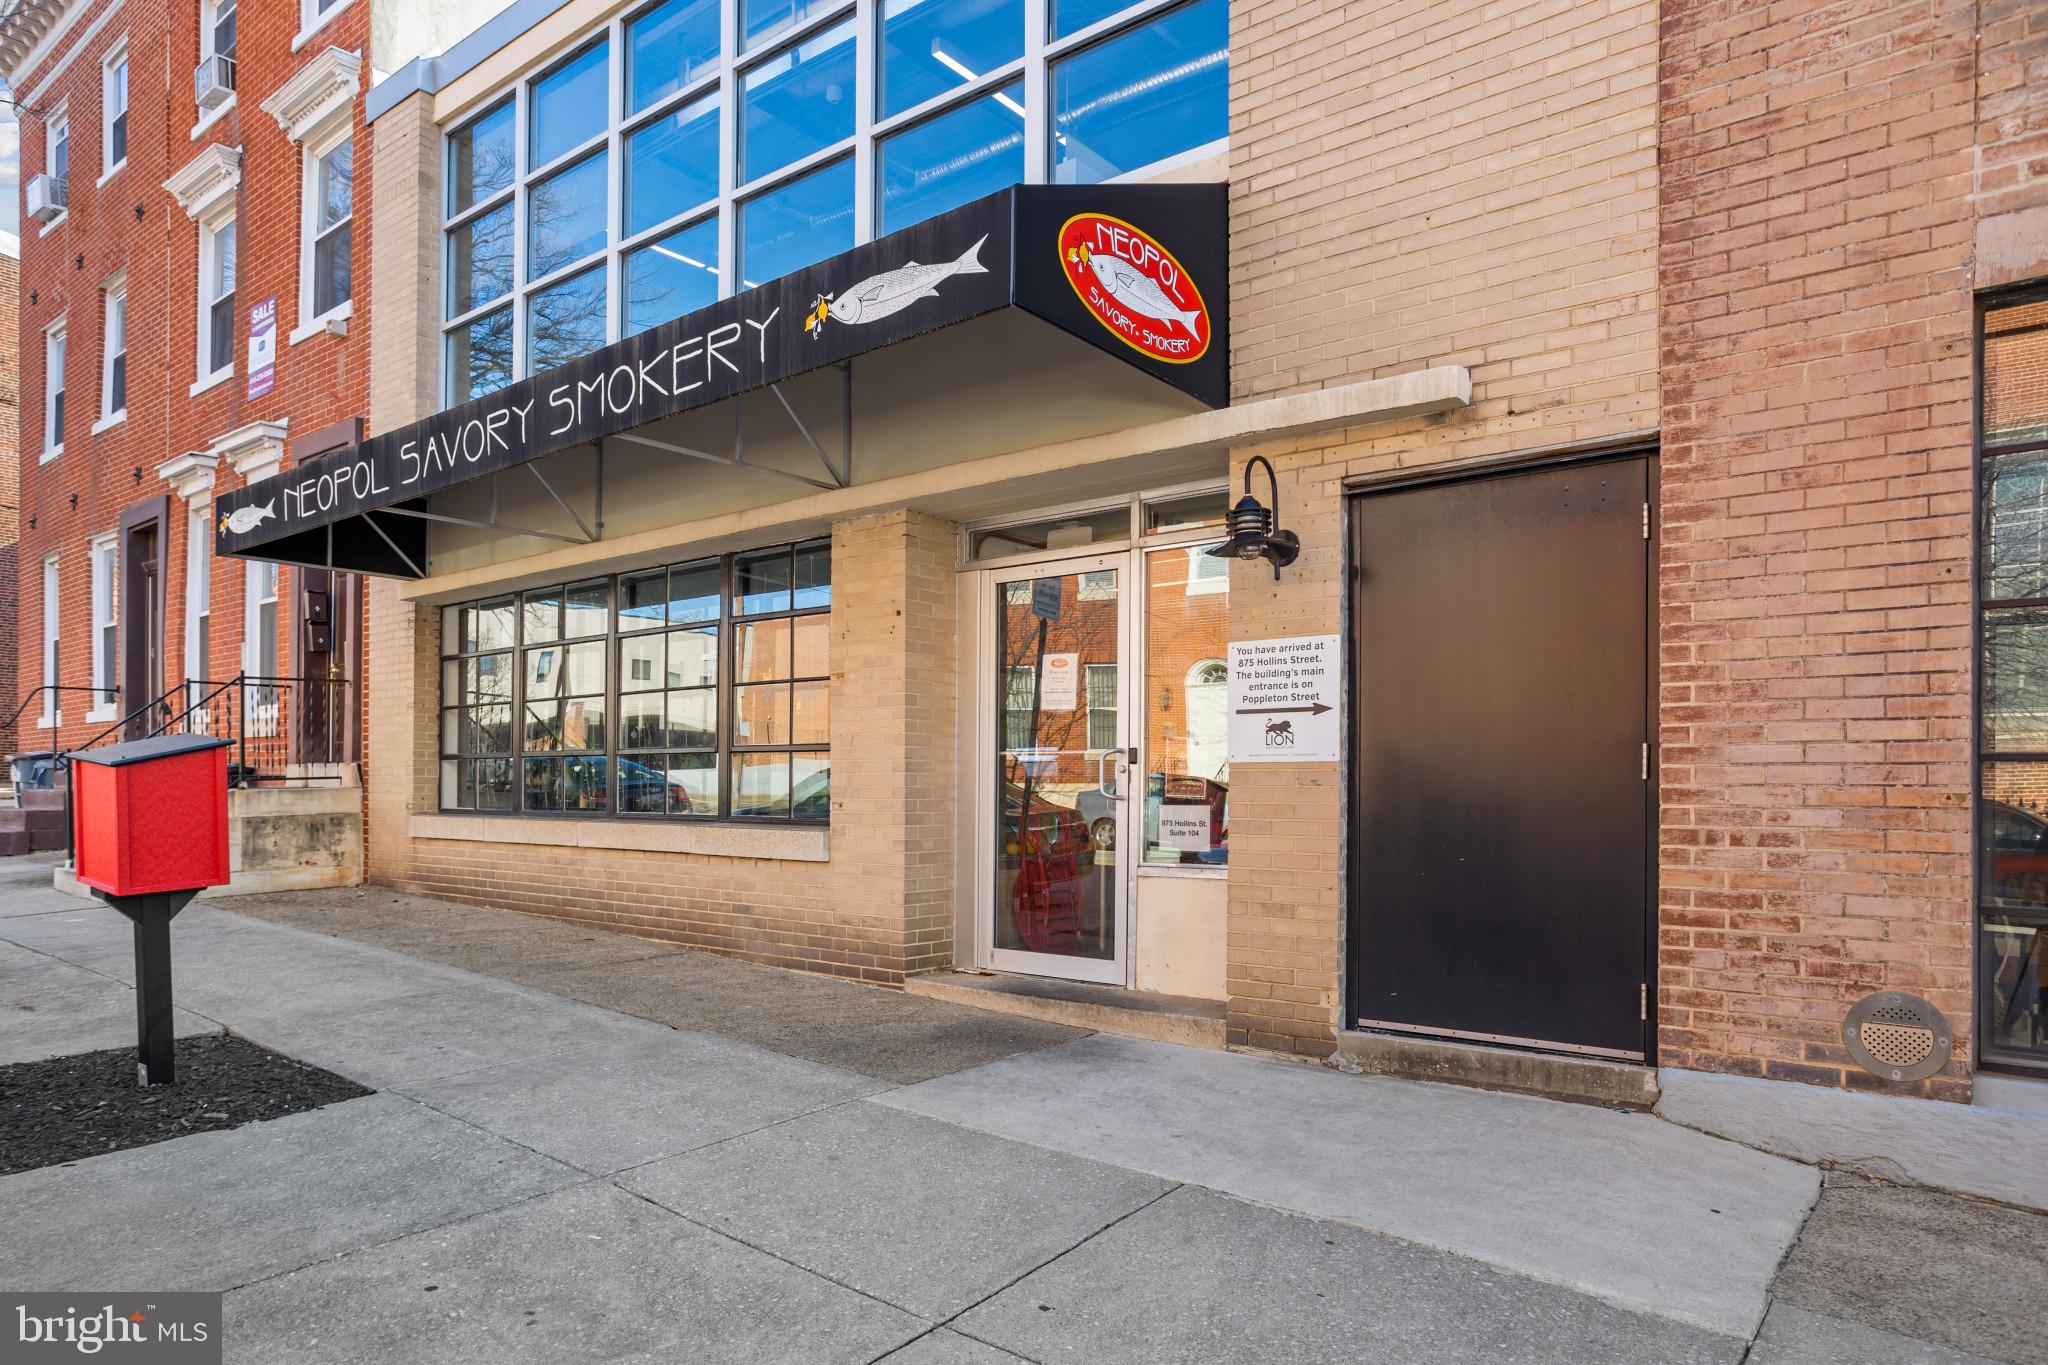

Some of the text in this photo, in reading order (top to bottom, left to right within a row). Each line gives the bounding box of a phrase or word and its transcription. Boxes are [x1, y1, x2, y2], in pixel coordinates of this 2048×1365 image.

[1096, 222, 1184, 303] NEOPOL
[252, 300, 274, 324] SALE
[1143, 330, 1190, 353] SMOKERY
[283, 306, 780, 521] NEOPOL SAVORY SMOKERY
[1236, 641, 1324, 656] You have arrived at
[1238, 655, 1322, 668] 875 Hollins Street.
[1236, 667, 1324, 680] The building's main
[1248, 680, 1313, 691] entrance is on
[1242, 692, 1320, 705] Poppleton Street
[1265, 733, 1294, 746] LION
[1198, 820, 1208, 828] St.
[1169, 829, 1200, 837] Suite 104
